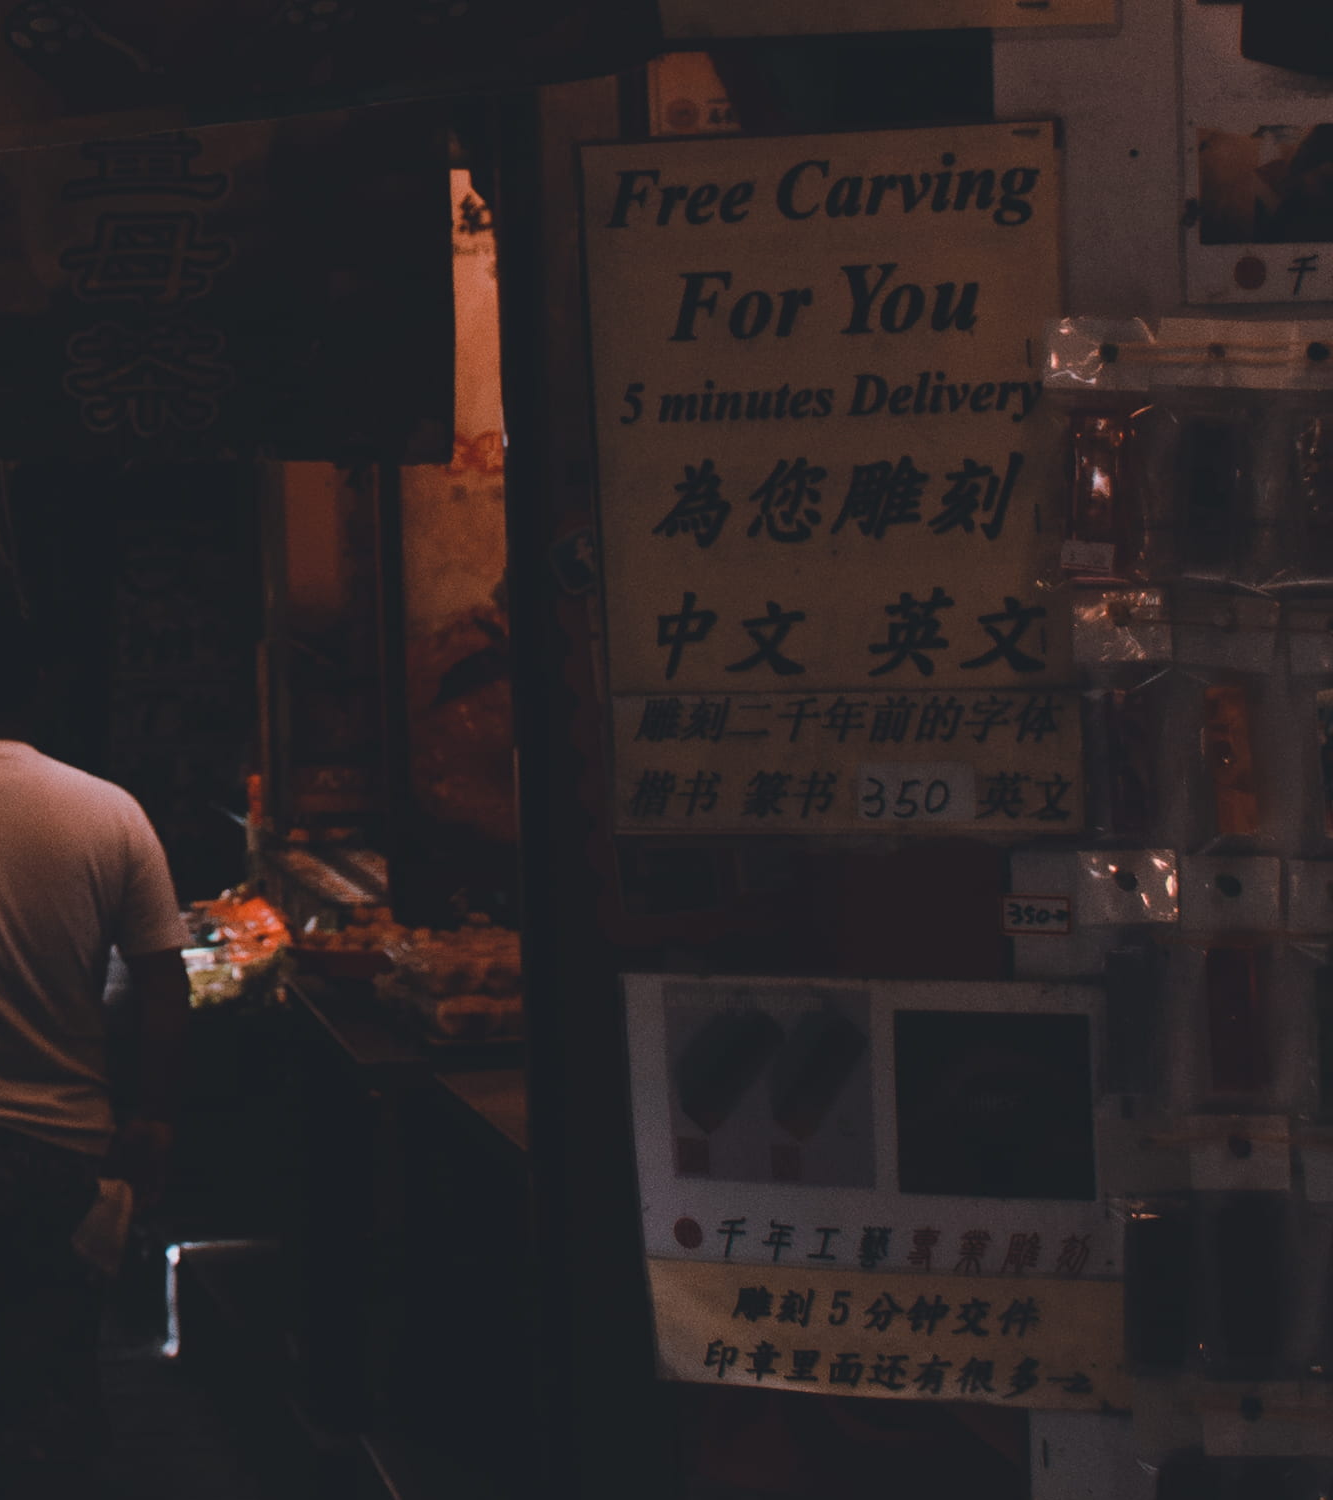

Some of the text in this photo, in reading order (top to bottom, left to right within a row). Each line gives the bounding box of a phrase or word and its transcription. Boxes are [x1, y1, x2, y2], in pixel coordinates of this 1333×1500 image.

[606, 152, 1040, 229] Free Carving
[668, 262, 980, 342] For You
[619, 370, 1044, 425] 5 minutes Delivery
[651, 450, 1024, 548] 為您雕刻
[653, 587, 1048, 681] 中文 英文
[629, 769, 723, 819] 楷书
[860, 776, 951, 819] 350
[974, 771, 1073, 822] 英文
[704, 1339, 1040, 1398] 印章里面还有很多
